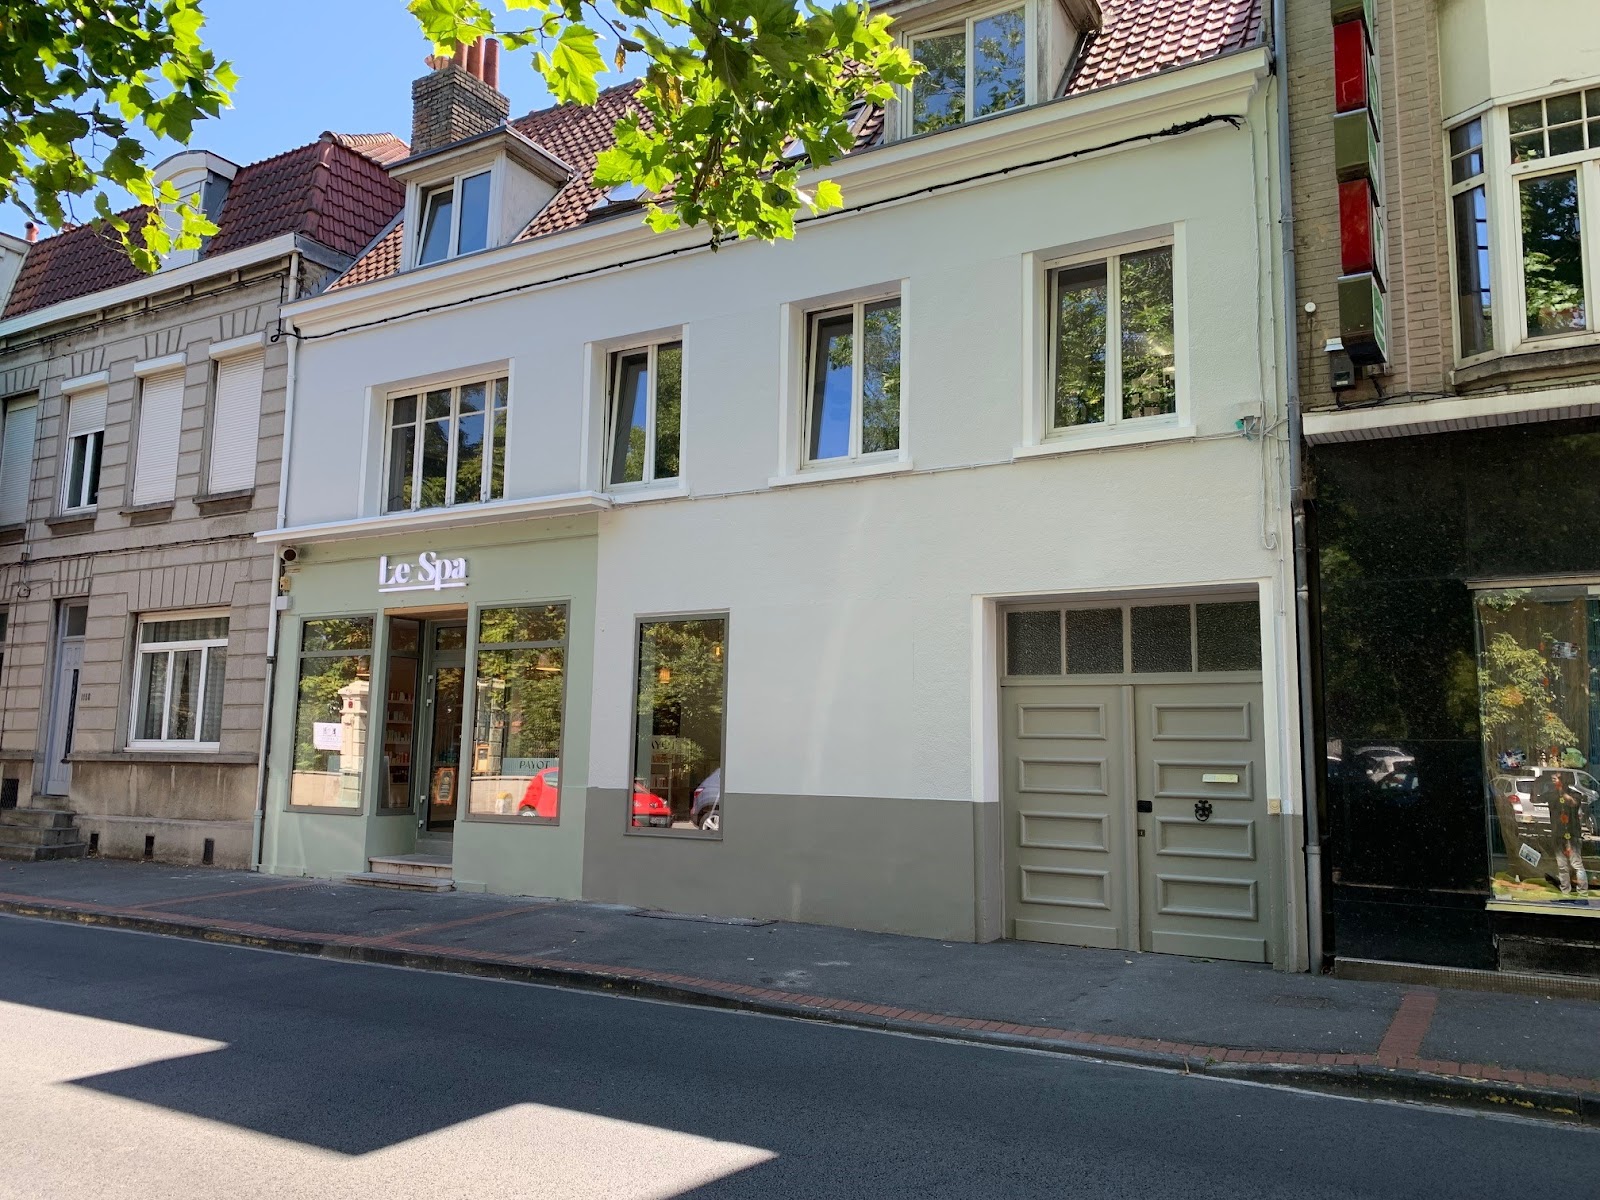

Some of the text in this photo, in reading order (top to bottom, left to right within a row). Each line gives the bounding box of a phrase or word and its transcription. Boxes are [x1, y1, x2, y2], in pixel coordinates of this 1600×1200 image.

[379, 551, 466, 591] Le Spa
[519, 760, 551, 770] PAYOT
